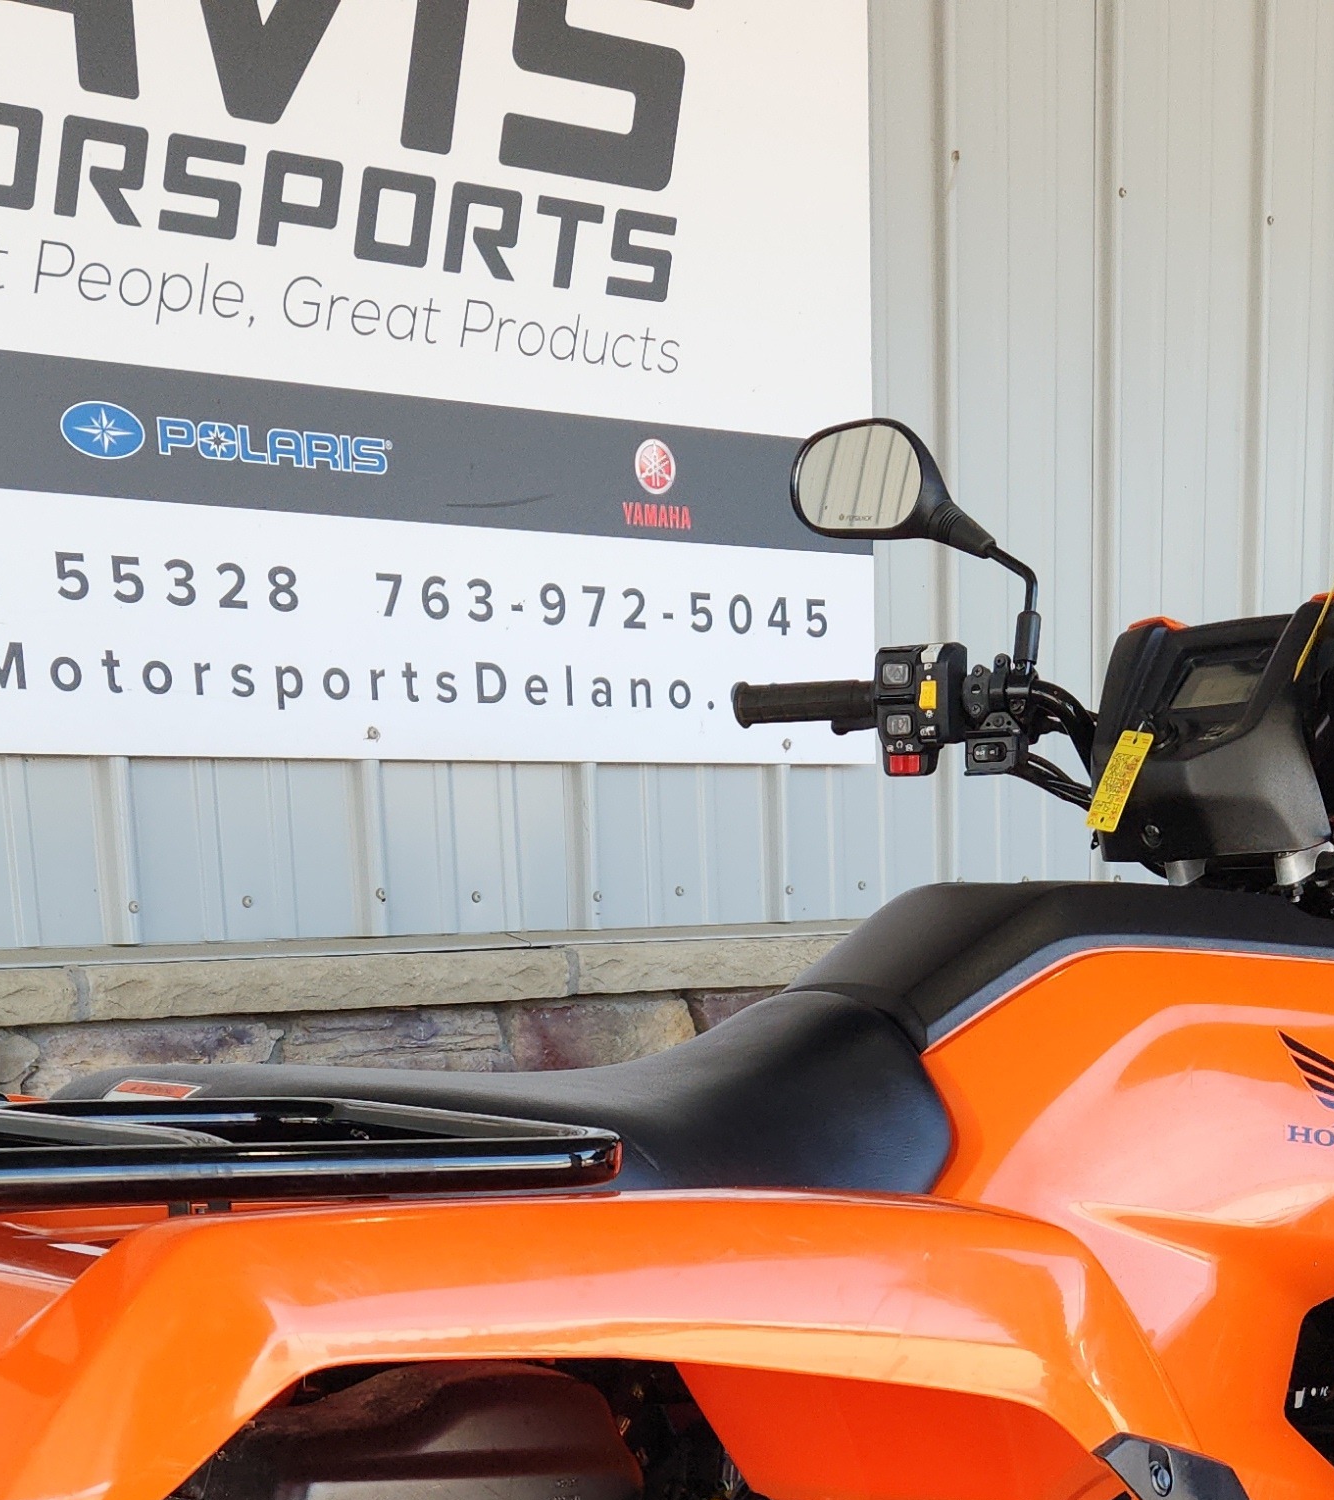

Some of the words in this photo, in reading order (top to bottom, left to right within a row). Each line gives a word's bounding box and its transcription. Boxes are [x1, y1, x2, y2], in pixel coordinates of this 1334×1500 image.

[34, 239, 256, 329] People,
[283, 276, 439, 346] Great
[463, 300, 681, 374] Products
[156, 416, 388, 475] POLARIS
[622, 501, 692, 530] YAMAHA
[54, 551, 299, 612] 55328
[375, 571, 829, 637] 763-972-5045
